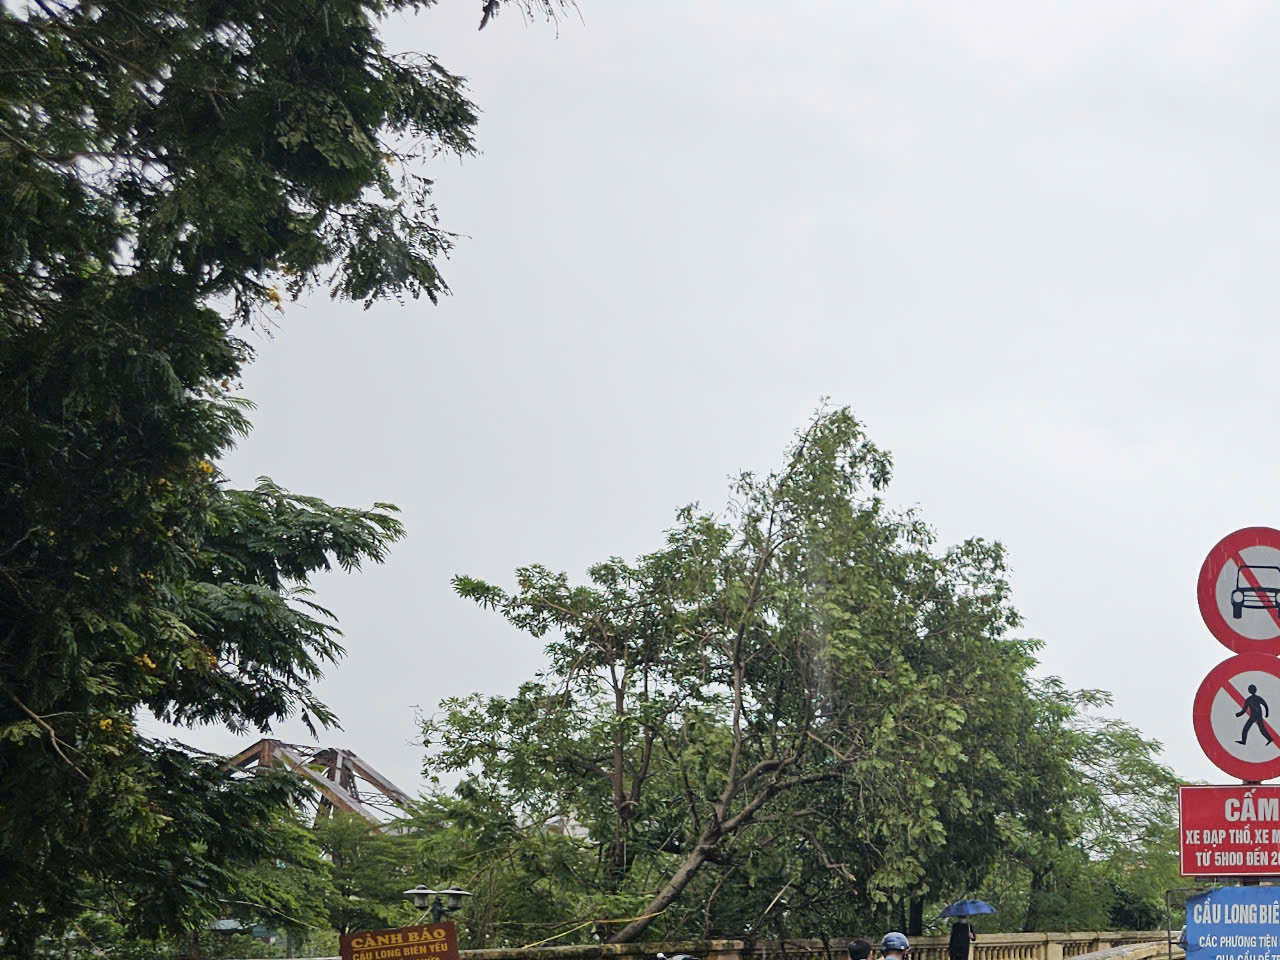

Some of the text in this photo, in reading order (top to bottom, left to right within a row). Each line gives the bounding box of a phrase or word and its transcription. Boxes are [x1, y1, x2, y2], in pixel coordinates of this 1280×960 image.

[1224, 788, 1279, 822] CẤM
[1185, 829, 1200, 845] XE
[1202, 829, 1226, 848] ĐẠP
[1254, 829, 1269, 844] XE
[1195, 849, 1212, 867] TỪ
[1214, 851, 1244, 866] 5H00
[1246, 847, 1268, 866] ĐẾN
[1193, 898, 1221, 924] CẦU
[1224, 904, 1257, 924] LONG
[351, 927, 446, 949] CẢNH BÁO
[1199, 933, 1218, 948] CÁC
[1220, 935, 1257, 948] PHƯƠNG
[1258, 933, 1278, 950] TIỆN
[375, 948, 401, 959] LONG
